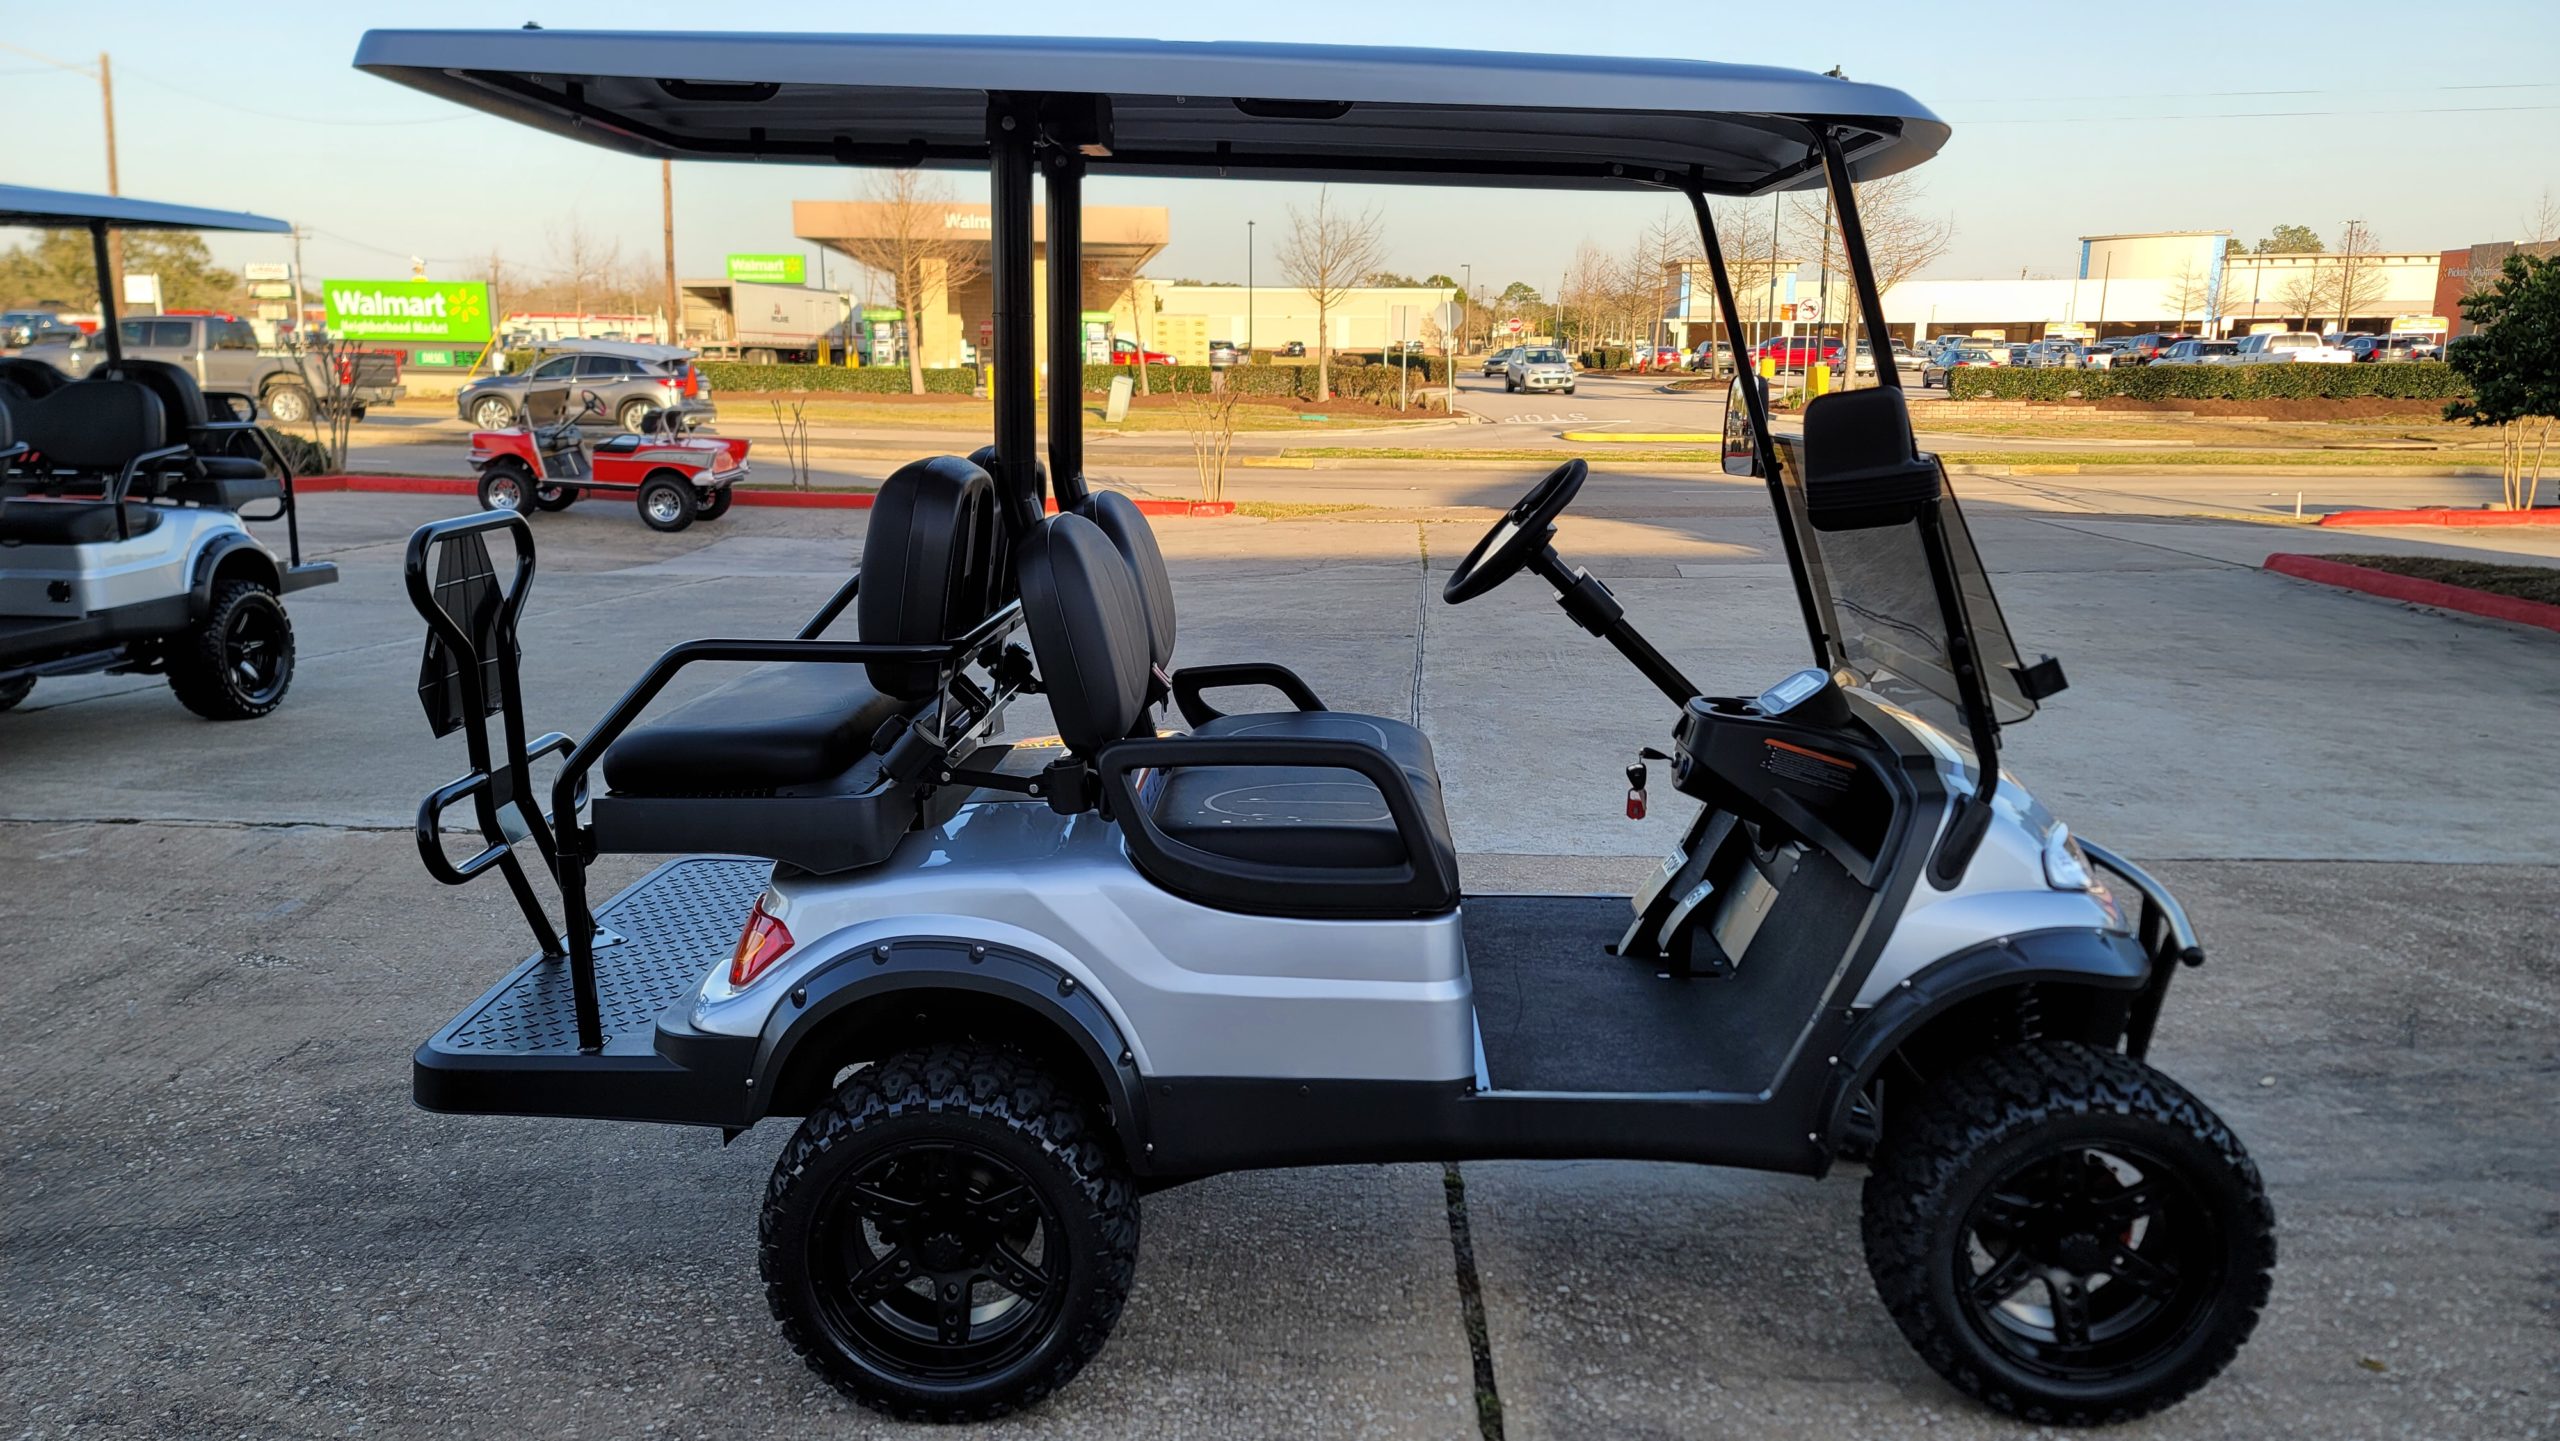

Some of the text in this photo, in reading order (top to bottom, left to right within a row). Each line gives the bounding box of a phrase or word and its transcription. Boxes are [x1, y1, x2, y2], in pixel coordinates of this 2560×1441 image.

[944, 213, 992, 229] Walm
[731, 258, 784, 272] Walmart
[332, 289, 447, 318] Walmart
[340, 320, 448, 335] Neighborhood Market
[1504, 413, 1588, 423] STOP
